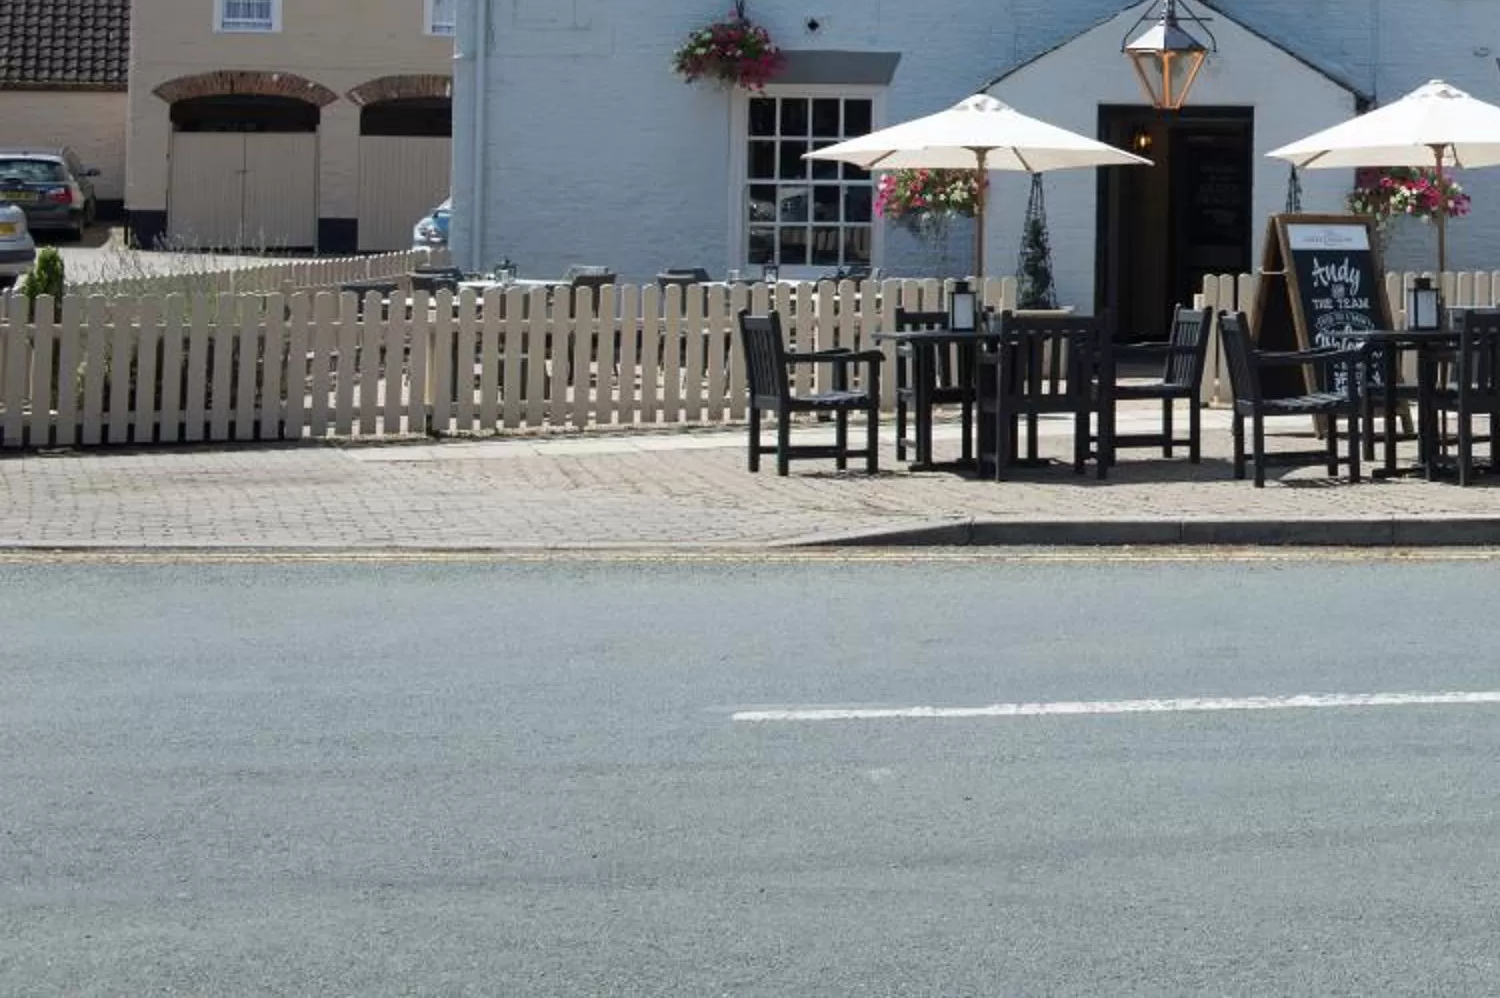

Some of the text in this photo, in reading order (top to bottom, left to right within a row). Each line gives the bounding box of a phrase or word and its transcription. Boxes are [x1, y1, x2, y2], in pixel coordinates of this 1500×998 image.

[1312, 256, 1360, 297] Andy
[1311, 297, 1370, 310] THE TEAM
